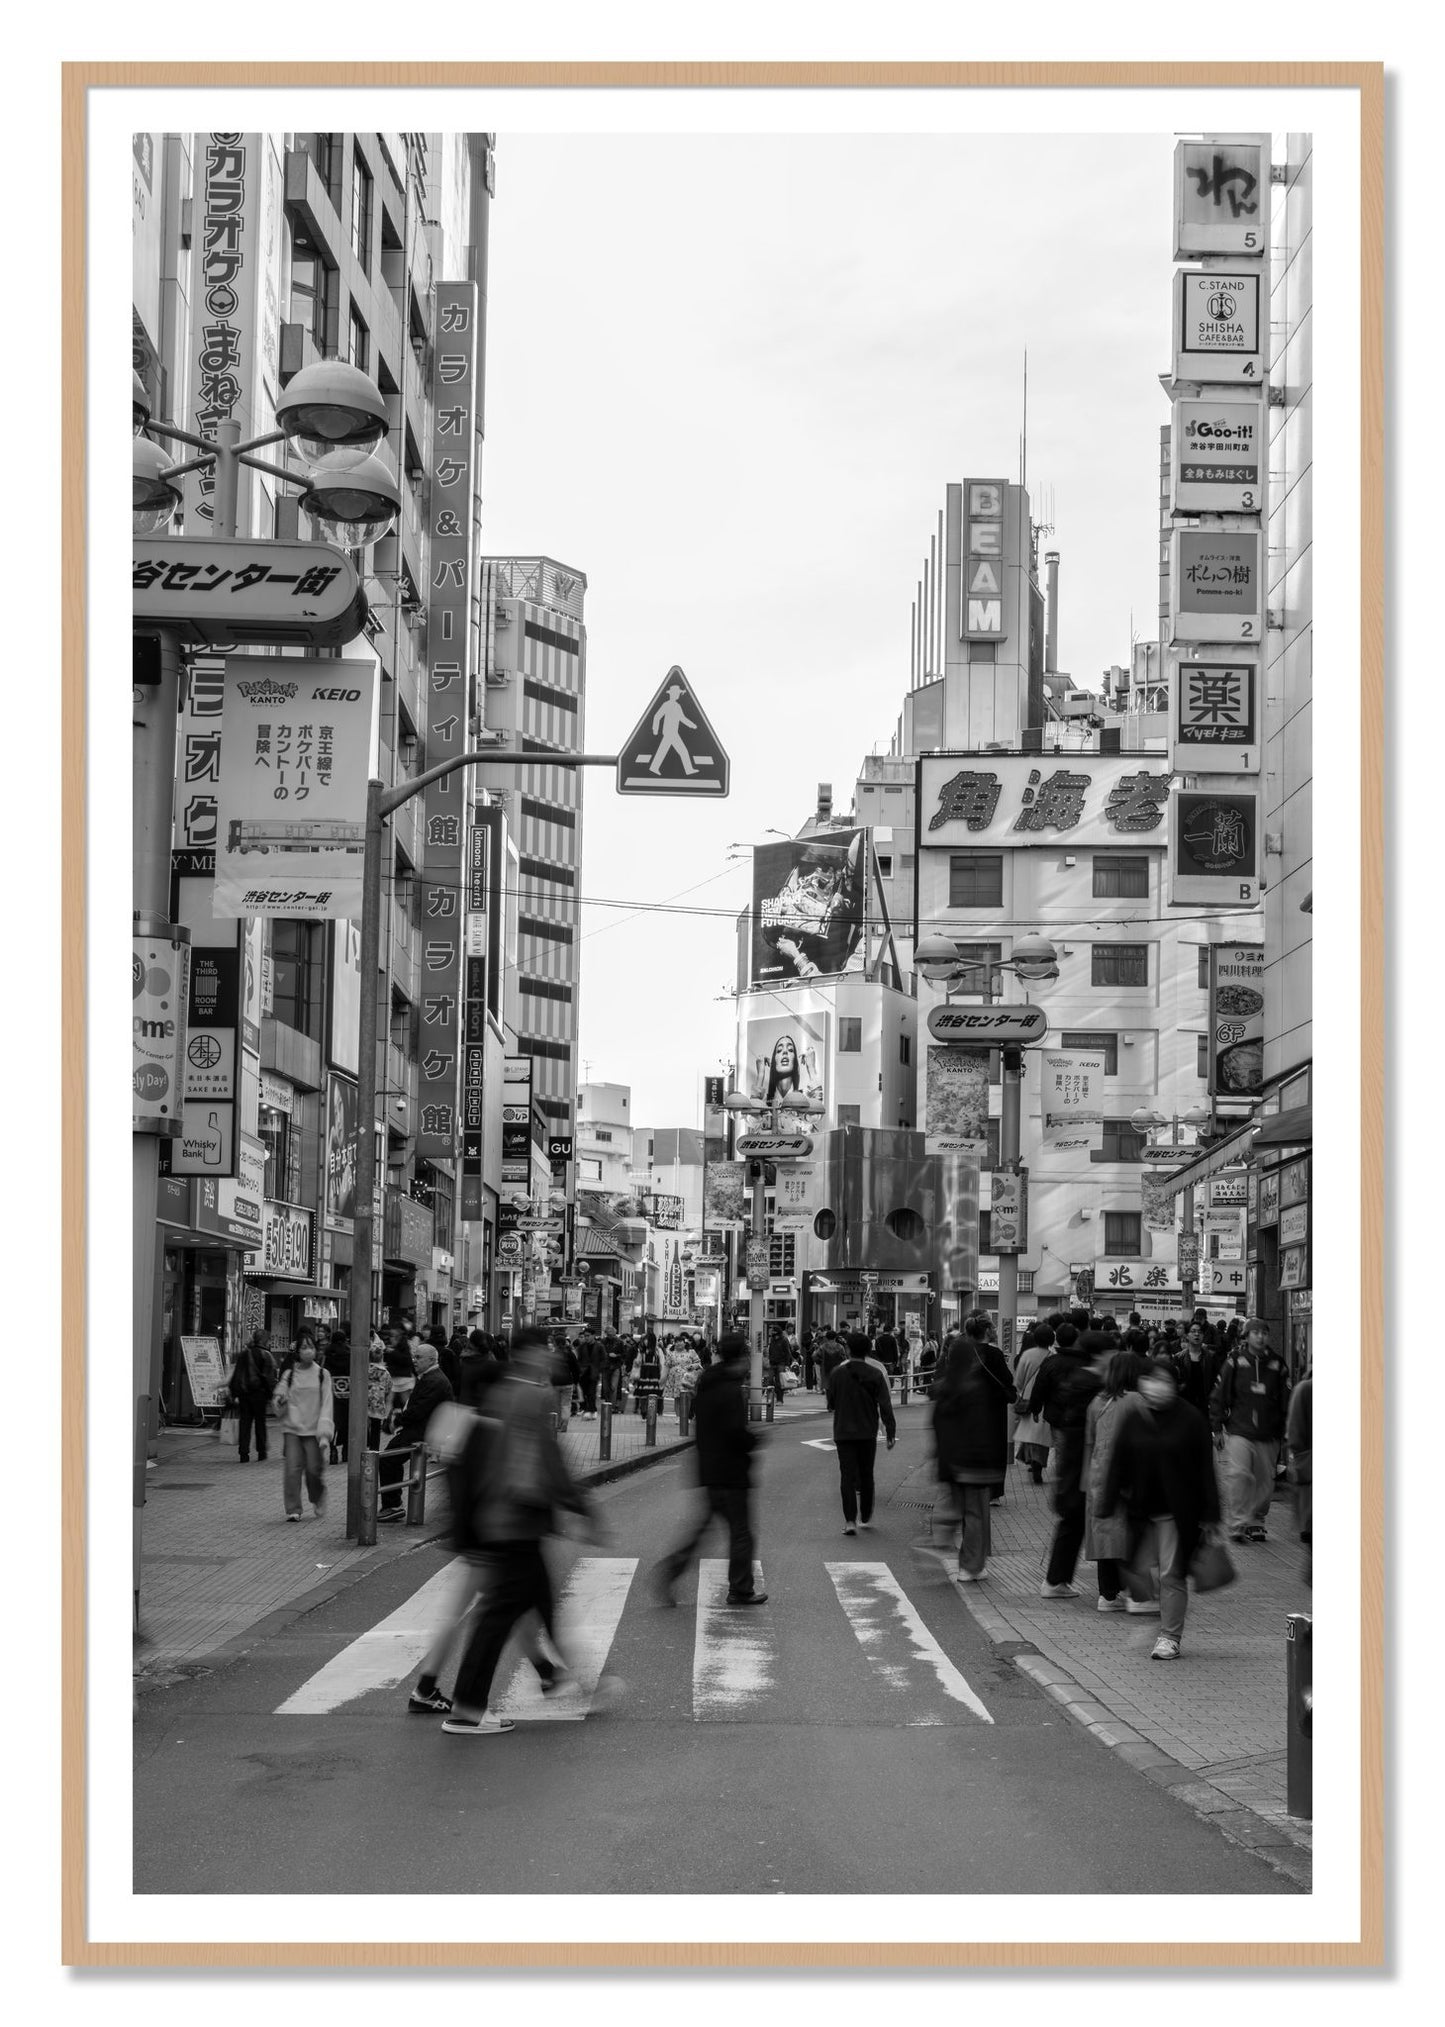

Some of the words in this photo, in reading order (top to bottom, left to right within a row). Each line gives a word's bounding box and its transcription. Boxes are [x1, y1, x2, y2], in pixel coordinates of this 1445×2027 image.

[203, 146, 246, 285] カラオケ
[1244, 232, 1257, 248] 5
[1199, 281, 1245, 290] C.STAND
[1199, 322, 1244, 333] SHISHA
[1199, 334, 1244, 342] CAFE&BAR
[1242, 361, 1256, 376] 4
[1197, 422, 1253, 438] Goo-it!
[1190, 442, 1250, 452] 渋谷宇田川町店
[1184, 467, 1254, 480] 全身もみほぐし
[1242, 492, 1254, 508] 3
[971, 485, 1000, 631] BEAM
[132, 560, 342, 596] 谷センター街
[1186, 564, 1251, 584] ポムの樹
[1196, 588, 1243, 596] Pomme-no-ki
[1241, 622, 1253, 637] 2
[312, 688, 361, 702] KEIO
[1189, 671, 1241, 723] 薬
[1183, 726, 1247, 741] マツモトキヨシ
[255, 725, 271, 768] 冒険へ
[274, 725, 292, 800] カントーの
[317, 726, 334, 786] 京王線で
[1241, 753, 1249, 768] 1
[928, 770, 1173, 832] 角海老
[1184, 811, 1246, 859] 一蘭
[474, 831, 483, 867] kimono
[473, 872, 483, 907] hearts
[1239, 883, 1251, 899] B
[242, 891, 333, 904] 渋谷センター街
[1219, 964, 1264, 978] 四川料理
[199, 1007, 213, 1015] BAR
[935, 1015, 1041, 1028] 渋谷センター街
[1216, 1024, 1246, 1043] 6F
[147, 1073, 167, 1088] Day!
[183, 1140, 217, 1150] Whisky
[551, 1143, 571, 1154] GU
[740, 1140, 804, 1149] 渋谷センター街
[182, 1150, 202, 1158] Bank
[671, 1264, 681, 1306] BEER
